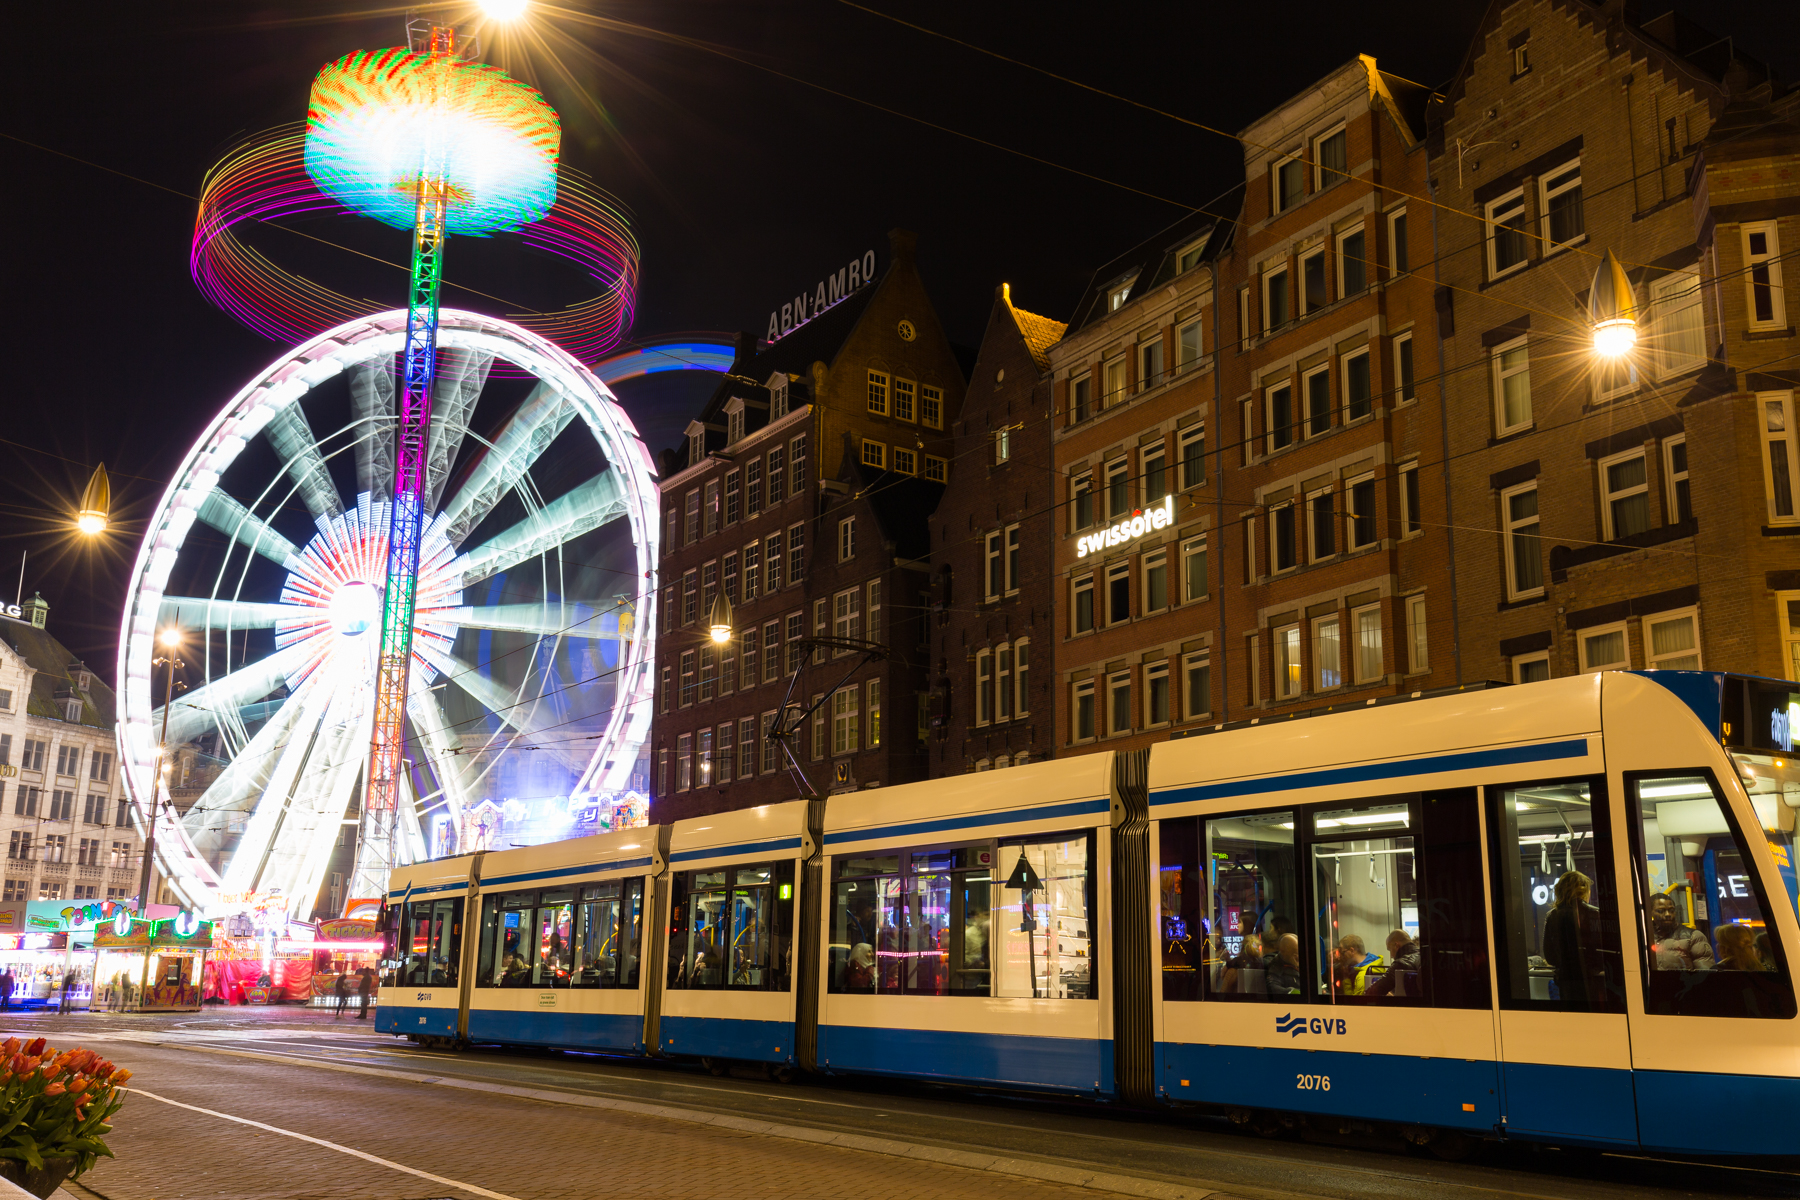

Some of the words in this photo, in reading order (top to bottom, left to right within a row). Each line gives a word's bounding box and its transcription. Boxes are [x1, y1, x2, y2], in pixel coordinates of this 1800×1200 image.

[329, 926, 377, 938] TICKETS
[1310, 1018, 1347, 1035] GVB
[1296, 1074, 1331, 1091] 2076
